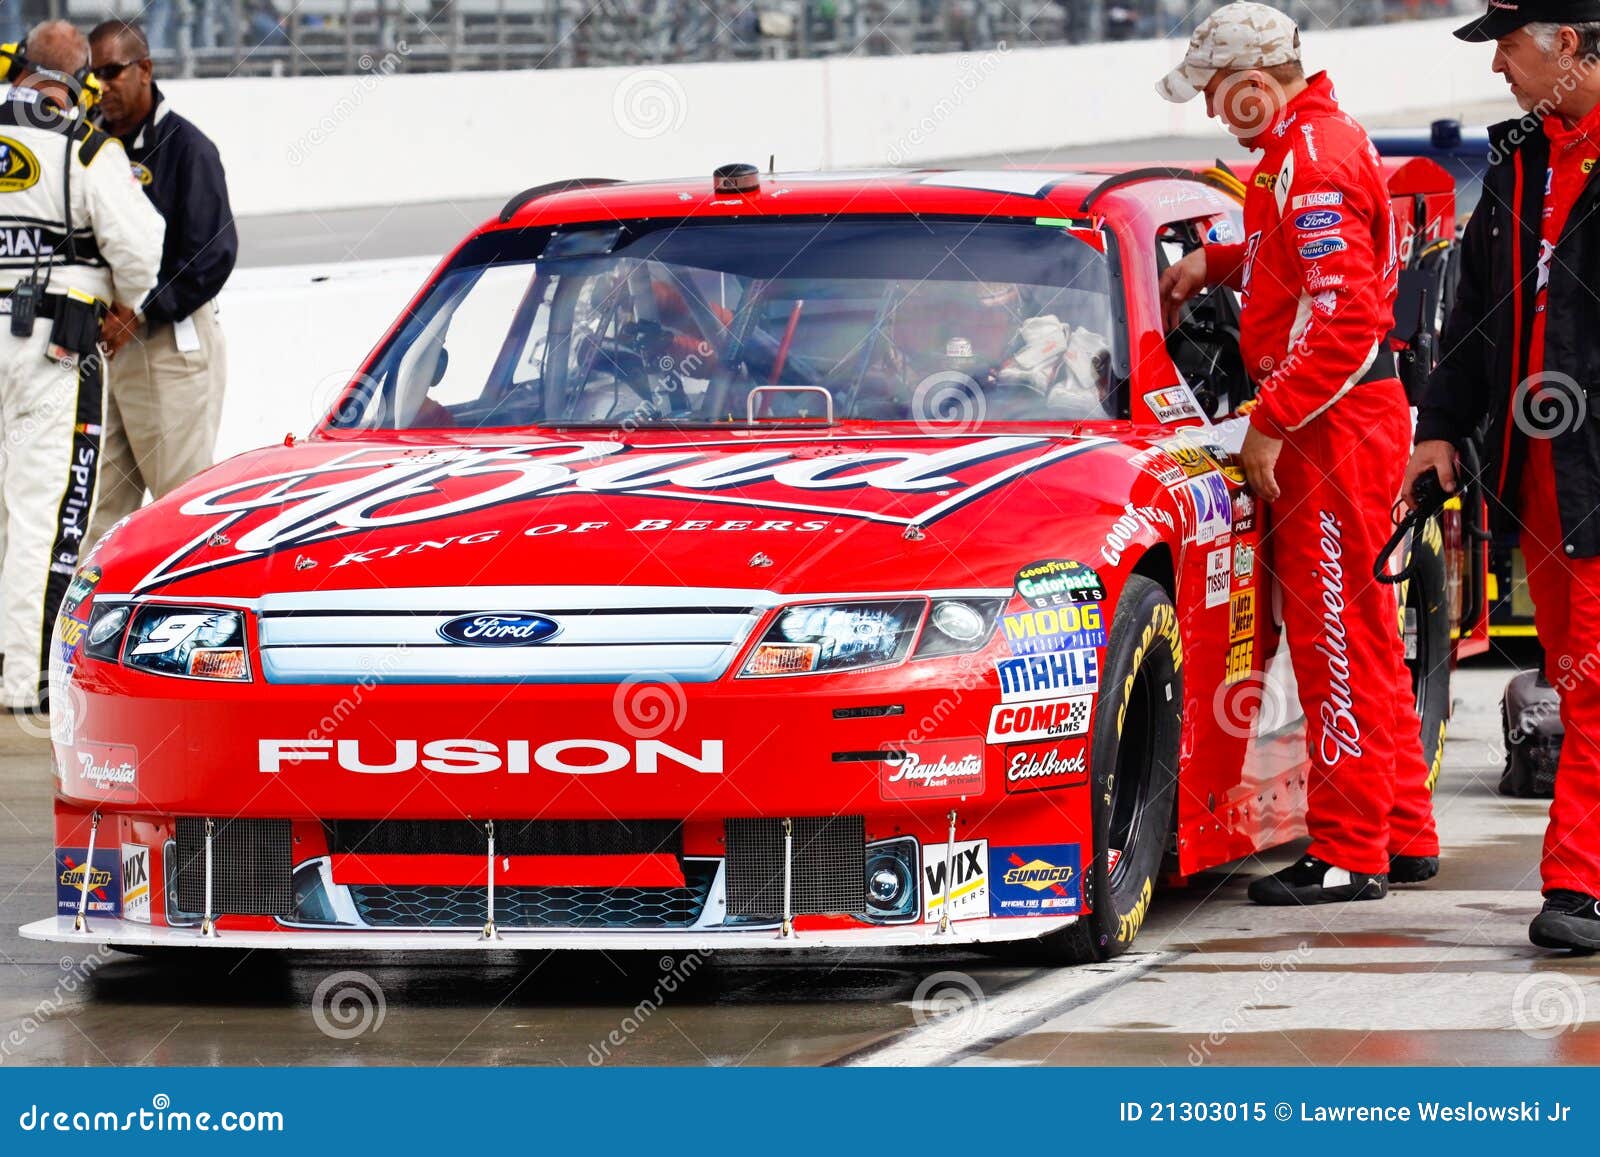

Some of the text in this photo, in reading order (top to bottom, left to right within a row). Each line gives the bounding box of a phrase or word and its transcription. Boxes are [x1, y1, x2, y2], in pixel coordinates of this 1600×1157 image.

[1303, 212, 1333, 227] Ford
[62, 446, 95, 539] Sprint
[180, 436, 1052, 552] Bud
[1101, 502, 1175, 567] GOODYEAR
[1235, 519, 1252, 532] POLE
[330, 530, 500, 568] KING
[523, 521, 608, 536] OF
[1017, 570, 1099, 599] Gatorback
[1020, 560, 1080, 579] GOODYEAR
[1207, 570, 1230, 594] TISSOT
[1035, 589, 1103, 608] BELTS
[1236, 595, 1251, 613] Auto
[130, 613, 219, 656] 9
[463, 616, 536, 639] Ford
[1003, 603, 1100, 641] MOOG
[1072, 629, 1105, 647] PARTS
[1314, 510, 1363, 766] Budweiser
[998, 650, 1097, 693] MAHLE
[994, 702, 1071, 735] COMP
[1047, 720, 1081, 735] CAMS
[77, 751, 135, 788] Raybestos
[259, 739, 723, 774] FUSION
[884, 753, 982, 787] Raybestos
[1008, 748, 1086, 783] Edelbrock
[930, 778, 948, 787] best
[122, 851, 147, 893] WIX
[925, 844, 983, 896] WIX
[1006, 867, 1071, 884] SUNOCO
[927, 888, 986, 920] FITERS
[1001, 900, 1025, 908] OFFICIAL
[1026, 899, 1039, 907] FUEL
